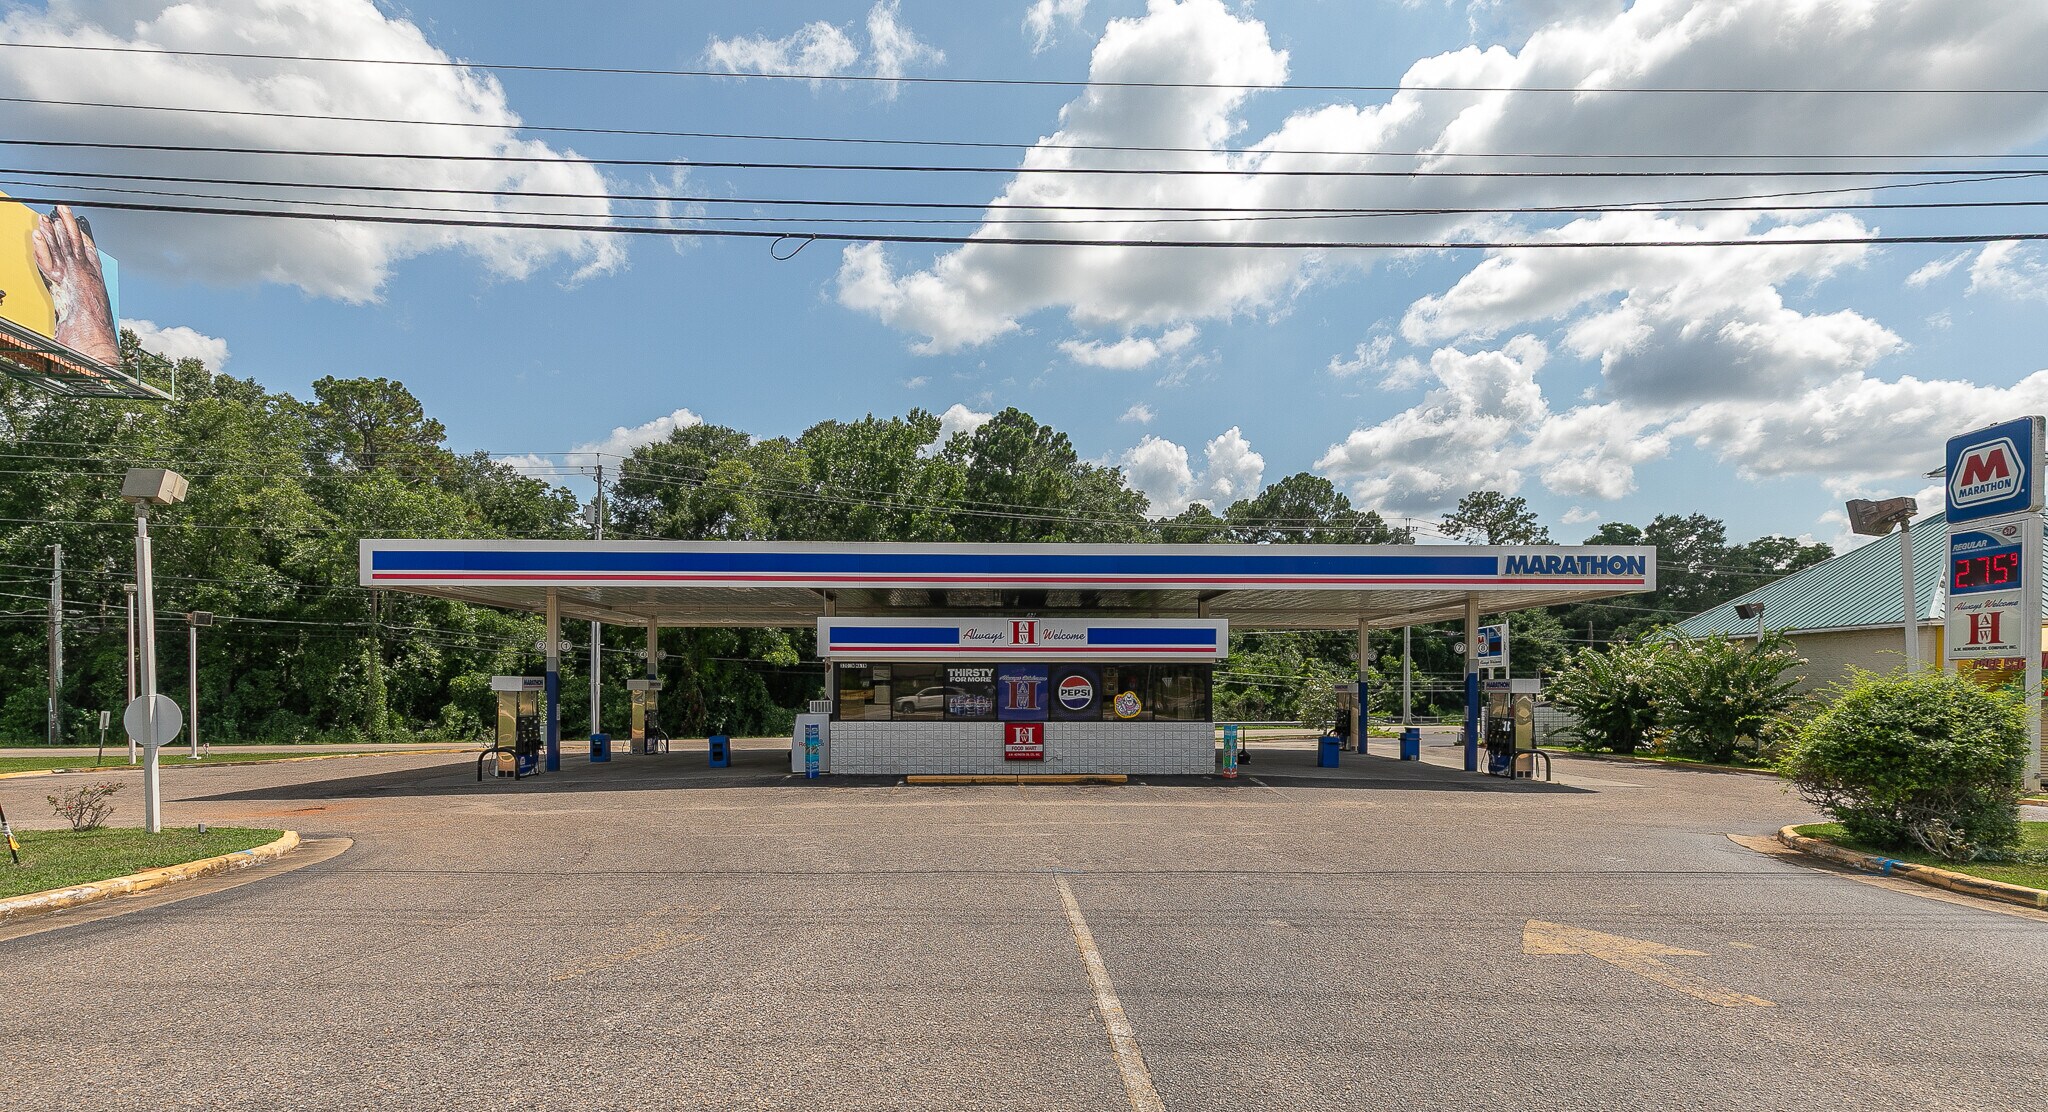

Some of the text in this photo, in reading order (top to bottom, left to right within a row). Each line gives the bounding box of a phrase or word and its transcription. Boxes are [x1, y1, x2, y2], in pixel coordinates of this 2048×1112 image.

[1958, 478, 2012, 499] MARATHON
[2003, 526, 2016, 535] STP
[1952, 540, 1988, 552] REGULAR
[1505, 555, 1646, 576] MARATHON
[1953, 599, 2019, 612] Always Welcome
[963, 628, 1086, 643] Always Welcome
[948, 669, 994, 677] THIRSTY
